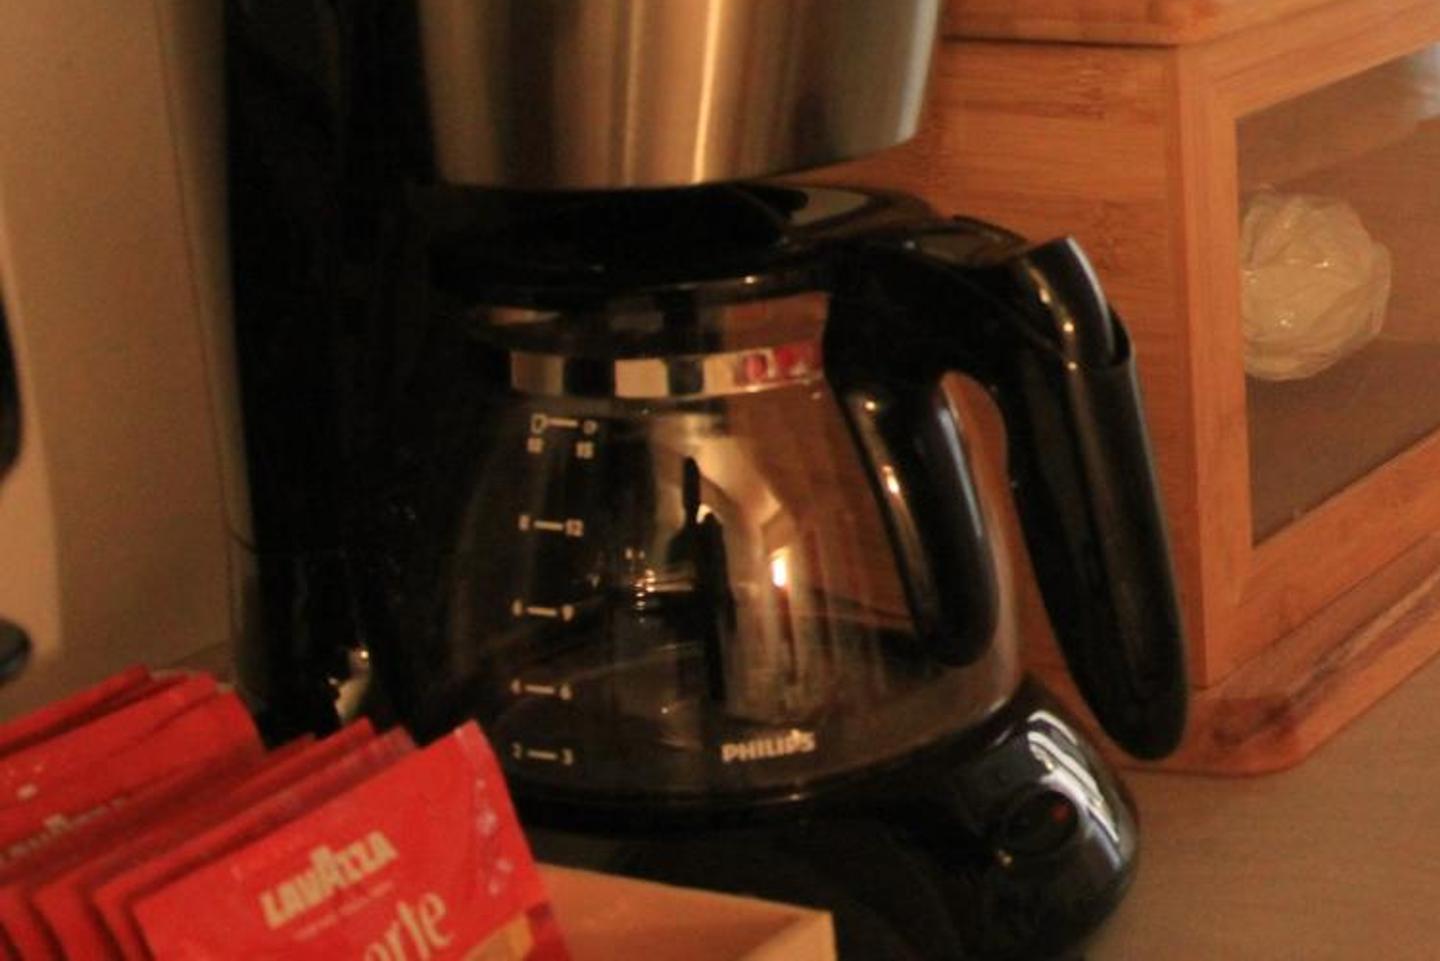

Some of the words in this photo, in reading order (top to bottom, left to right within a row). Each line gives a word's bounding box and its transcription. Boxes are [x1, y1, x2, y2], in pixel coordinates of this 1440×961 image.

[565, 519, 584, 538] 12
[721, 729, 816, 763] PHILIPS
[259, 830, 399, 929] LAVAZZA
